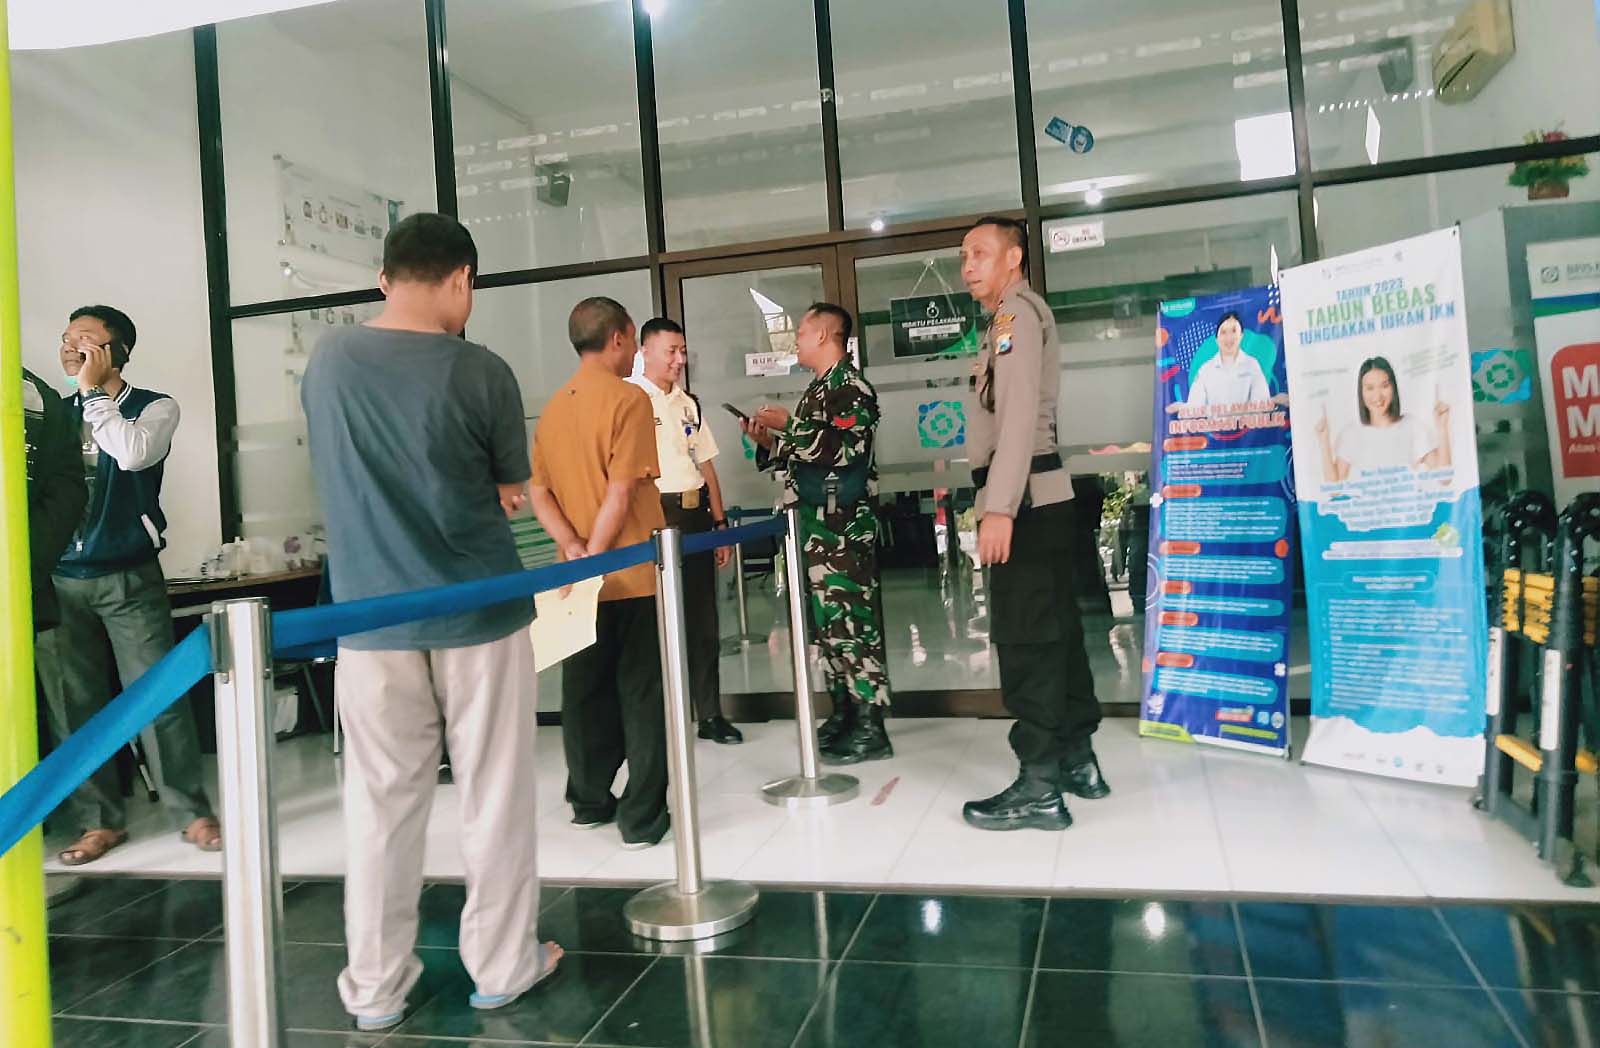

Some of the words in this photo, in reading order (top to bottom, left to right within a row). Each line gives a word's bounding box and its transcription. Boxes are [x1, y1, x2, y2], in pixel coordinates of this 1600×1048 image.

[1306, 301, 1365, 328] TAHUN
[1371, 283, 1437, 315] BEBAS
[1298, 319, 1376, 345] TUNGGAKAN
